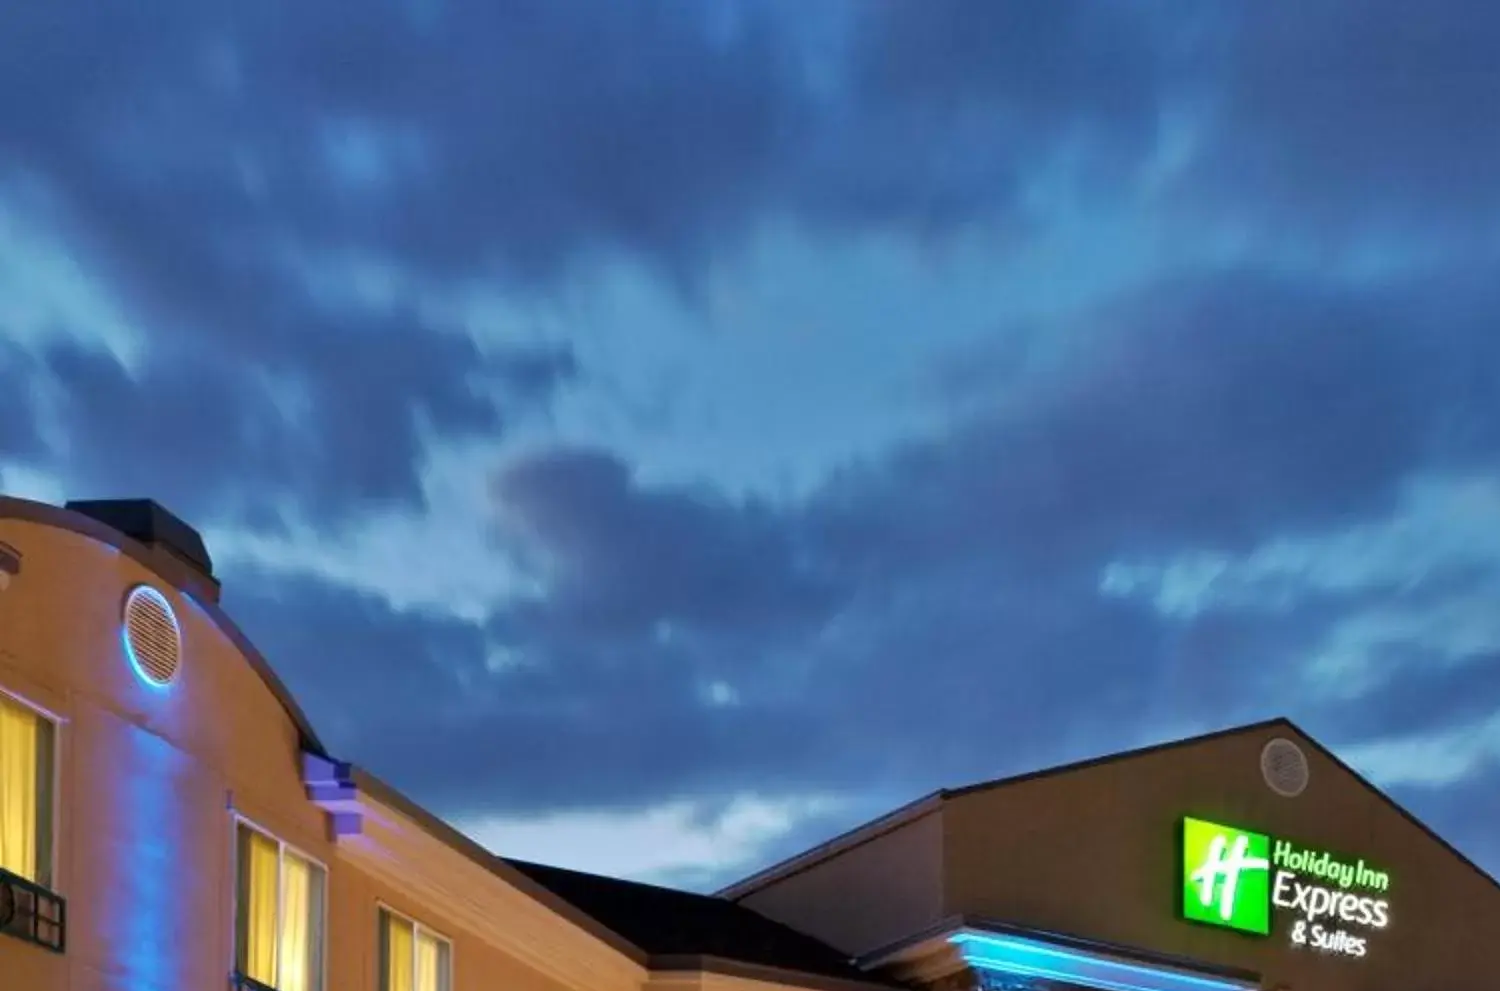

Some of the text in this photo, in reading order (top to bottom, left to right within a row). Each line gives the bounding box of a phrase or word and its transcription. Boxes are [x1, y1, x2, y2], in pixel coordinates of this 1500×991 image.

[1273, 840, 1389, 891] Holiday Inn
[1272, 870, 1389, 928] Express
[1291, 920, 1367, 957] & Suites
